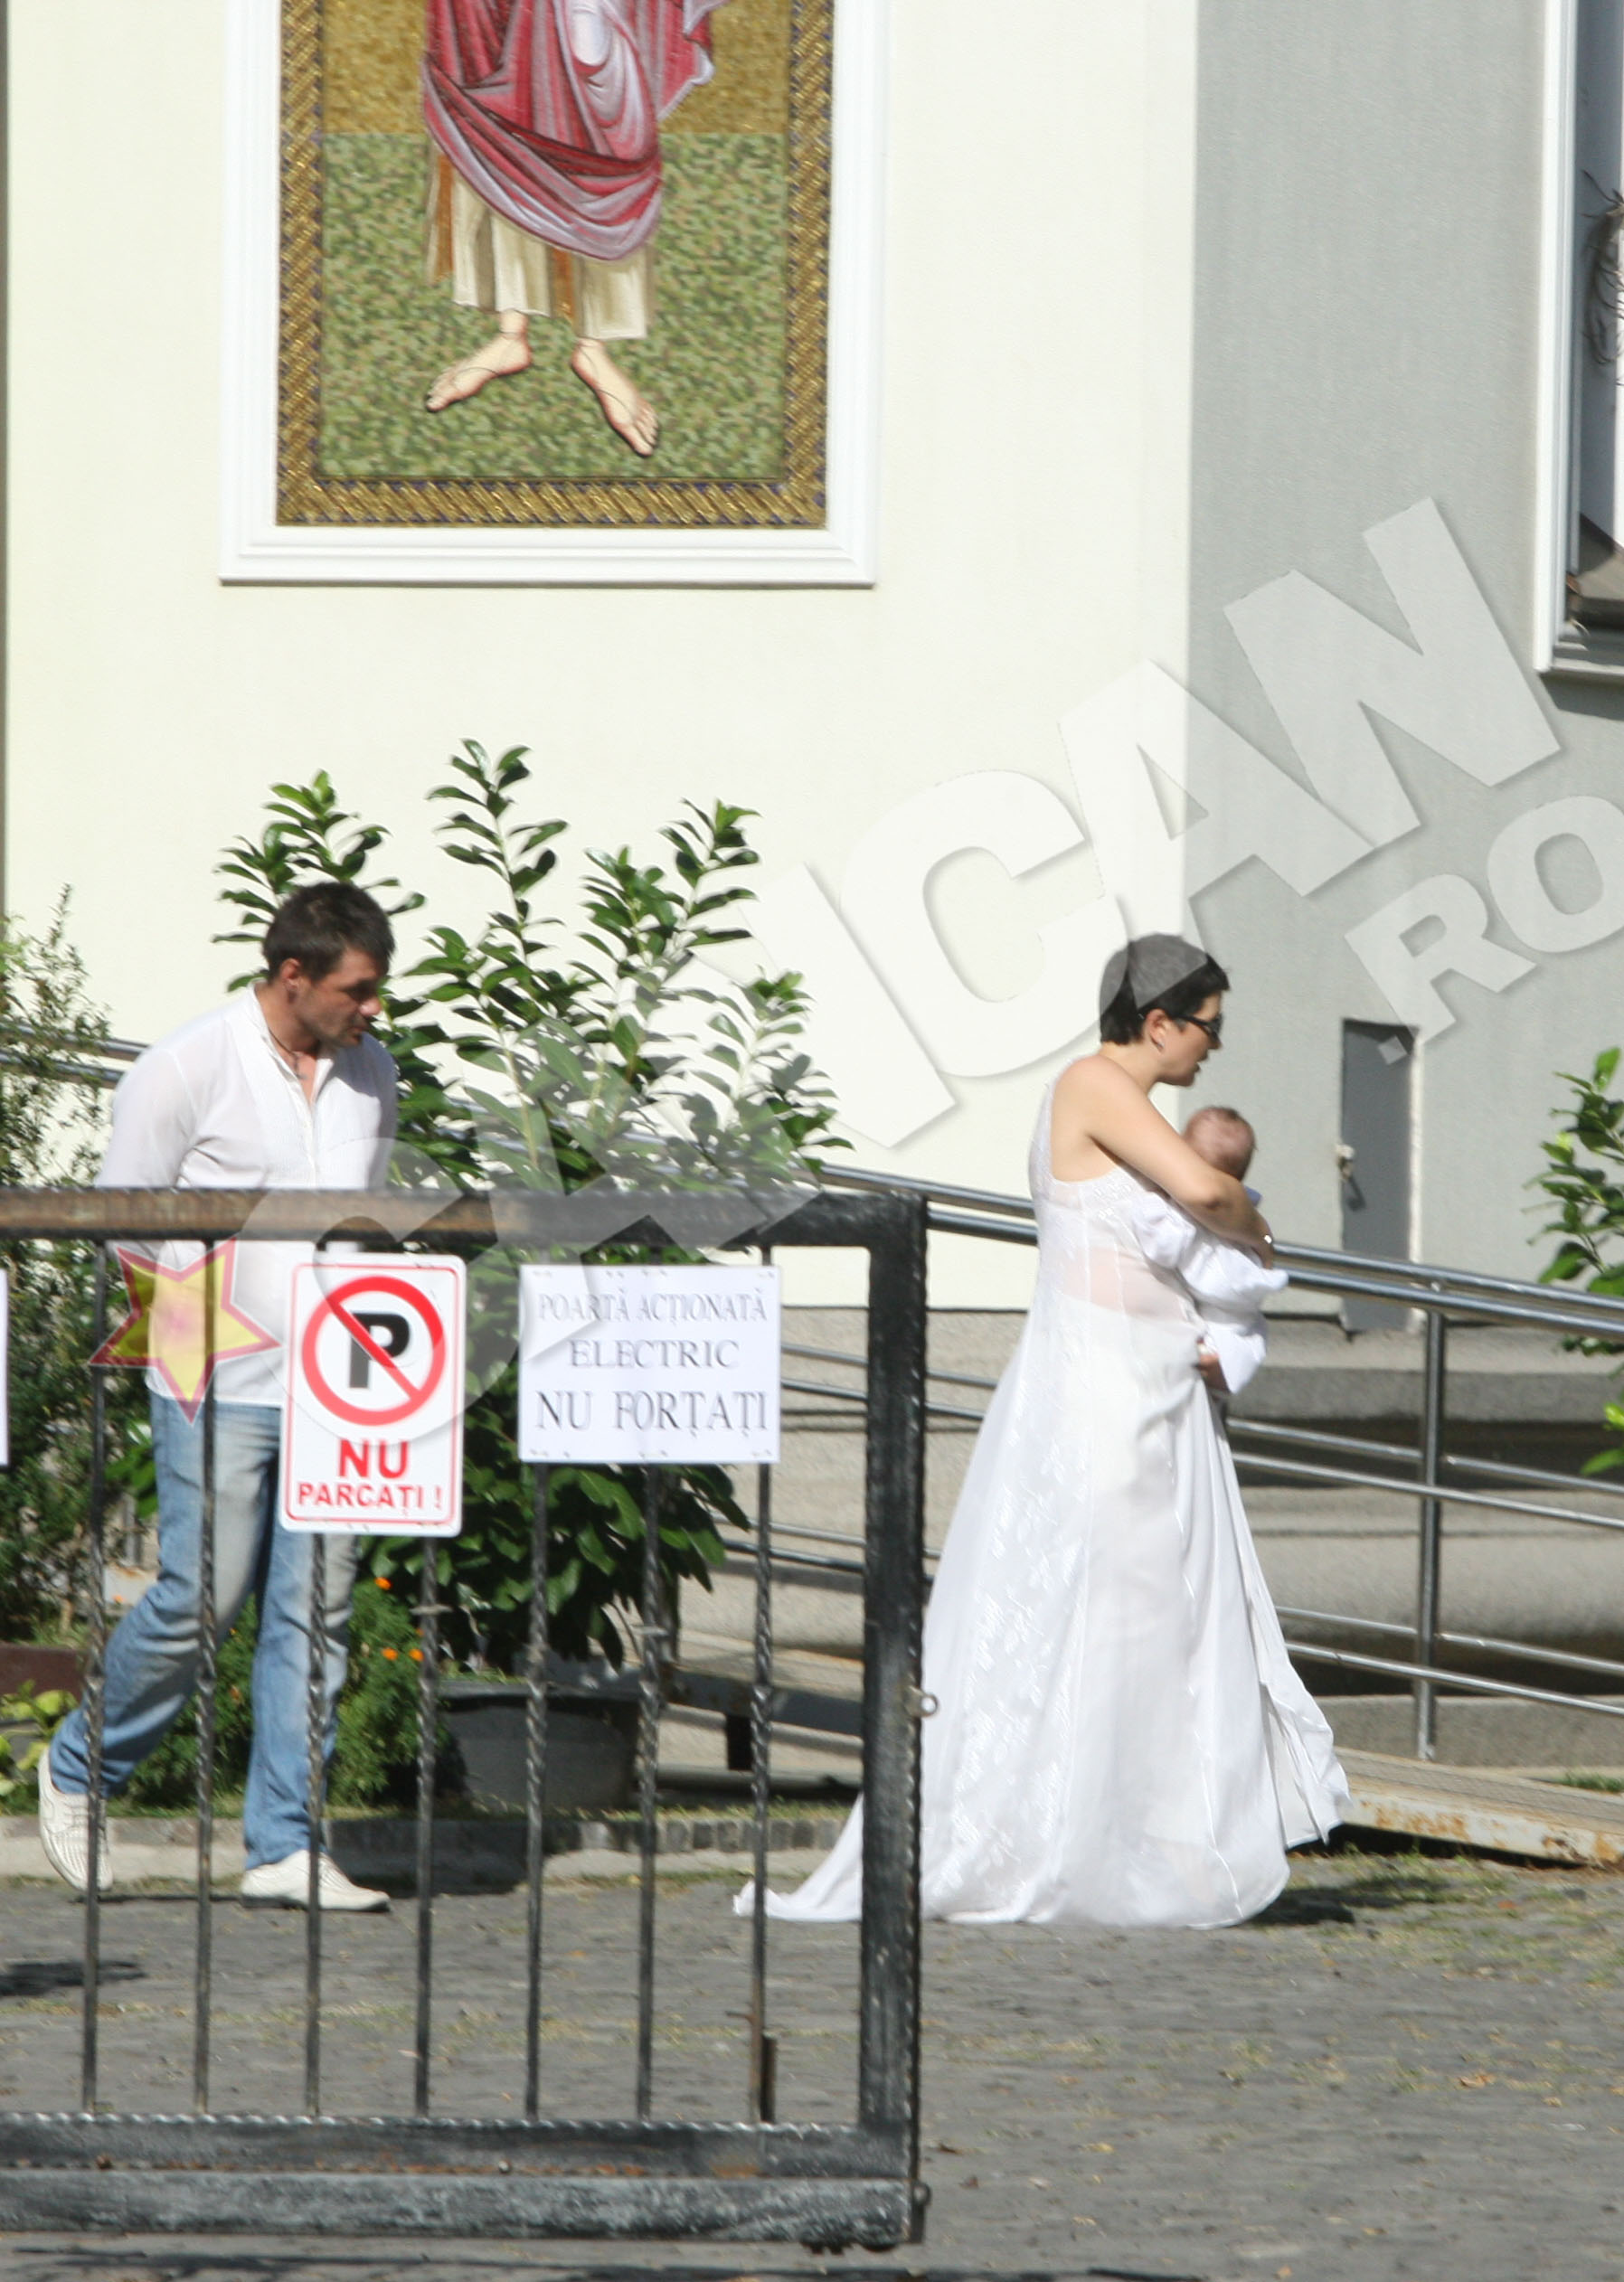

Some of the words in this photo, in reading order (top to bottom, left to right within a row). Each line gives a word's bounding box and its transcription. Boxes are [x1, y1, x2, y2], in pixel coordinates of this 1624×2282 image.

[349, 1312, 411, 1389] P
[569, 1338, 740, 1369] ELECTRIC
[534, 1389, 593, 1430] NU
[338, 1438, 409, 1479] NU
